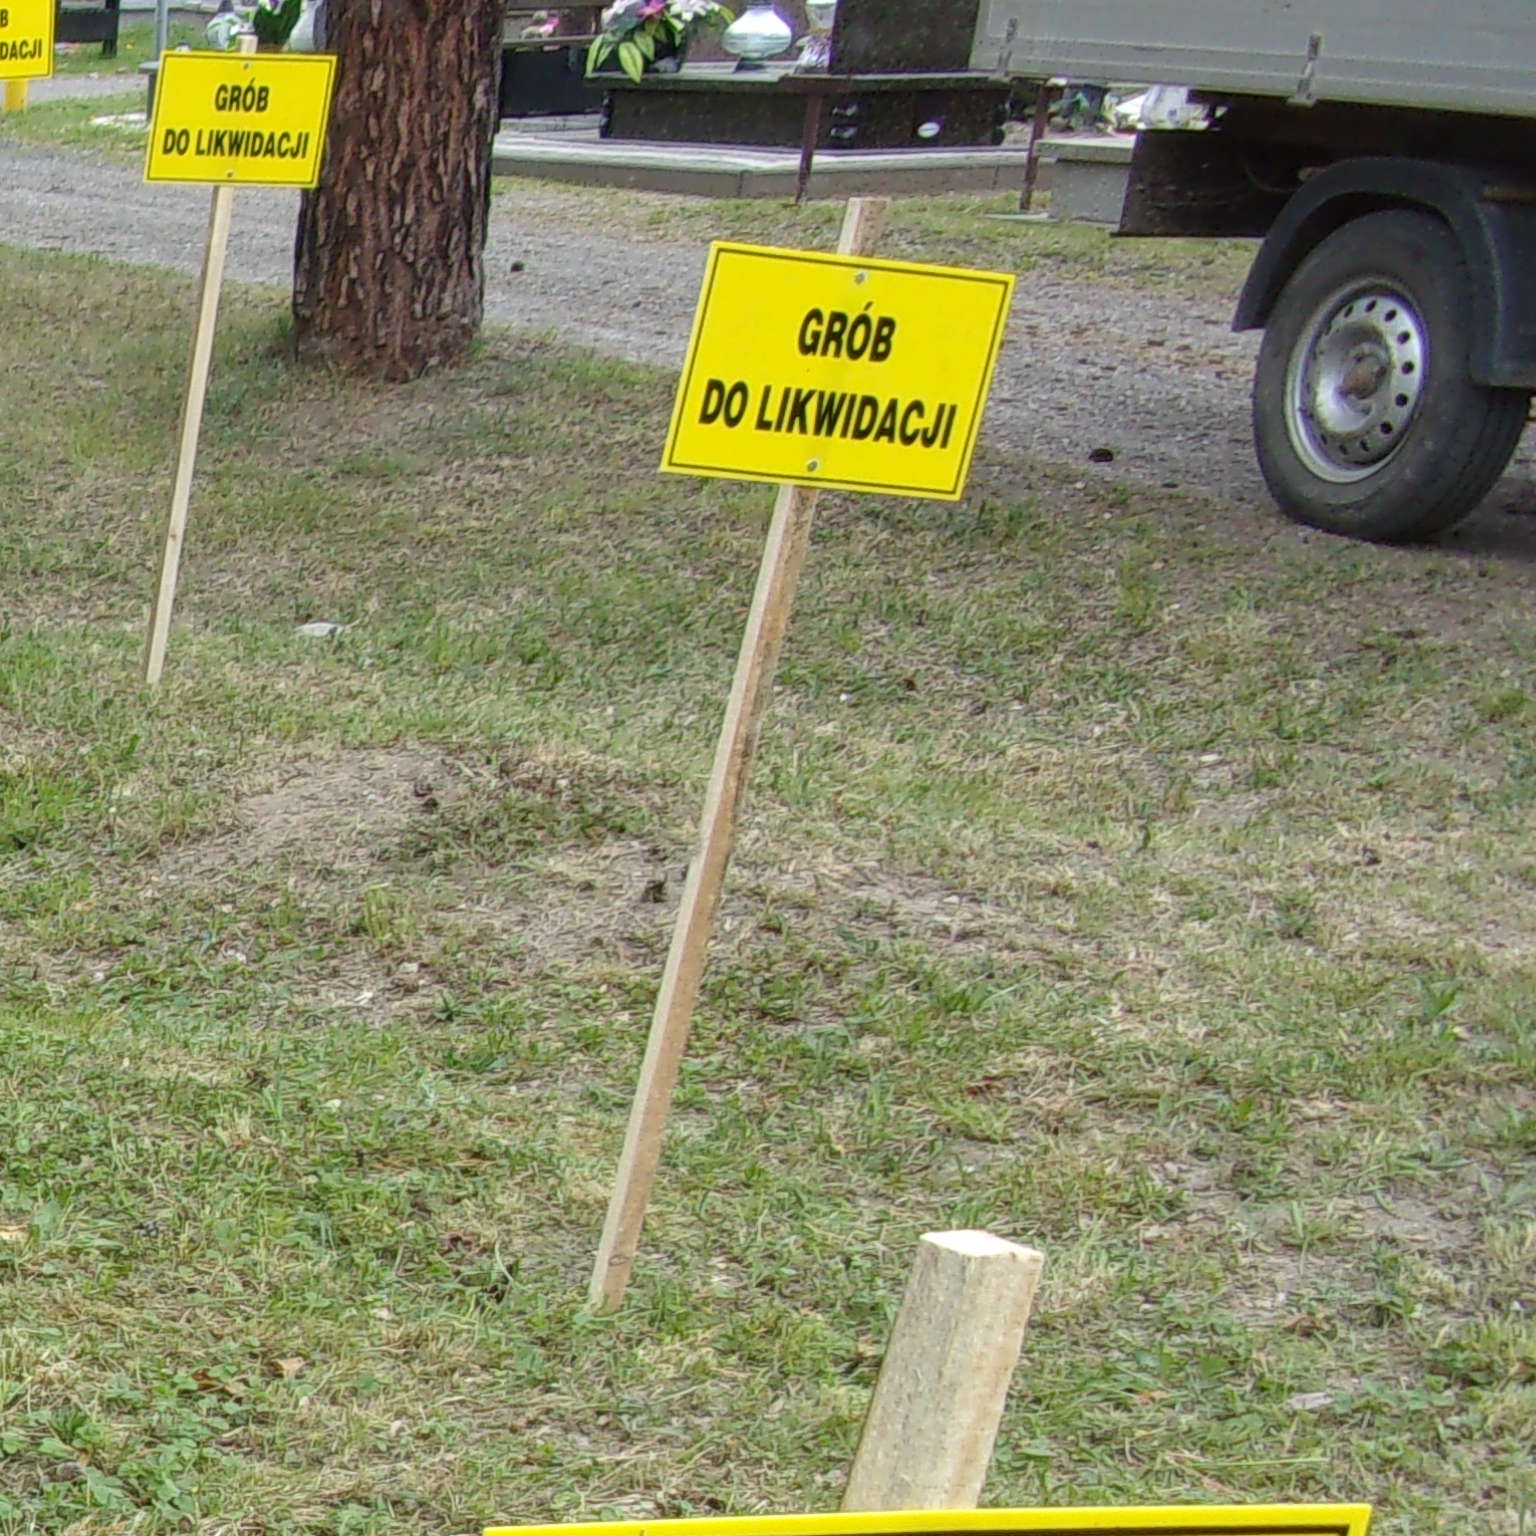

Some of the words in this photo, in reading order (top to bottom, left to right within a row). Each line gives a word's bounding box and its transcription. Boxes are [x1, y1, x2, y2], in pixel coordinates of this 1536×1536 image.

[214, 77, 271, 113] GRÓB
[162, 128, 191, 156] DO
[194, 129, 310, 160] LIKWIDACJI
[798, 302, 897, 363] GRÓB
[697, 378, 749, 428] DO
[754, 384, 958, 450] LIKWIDACJI
